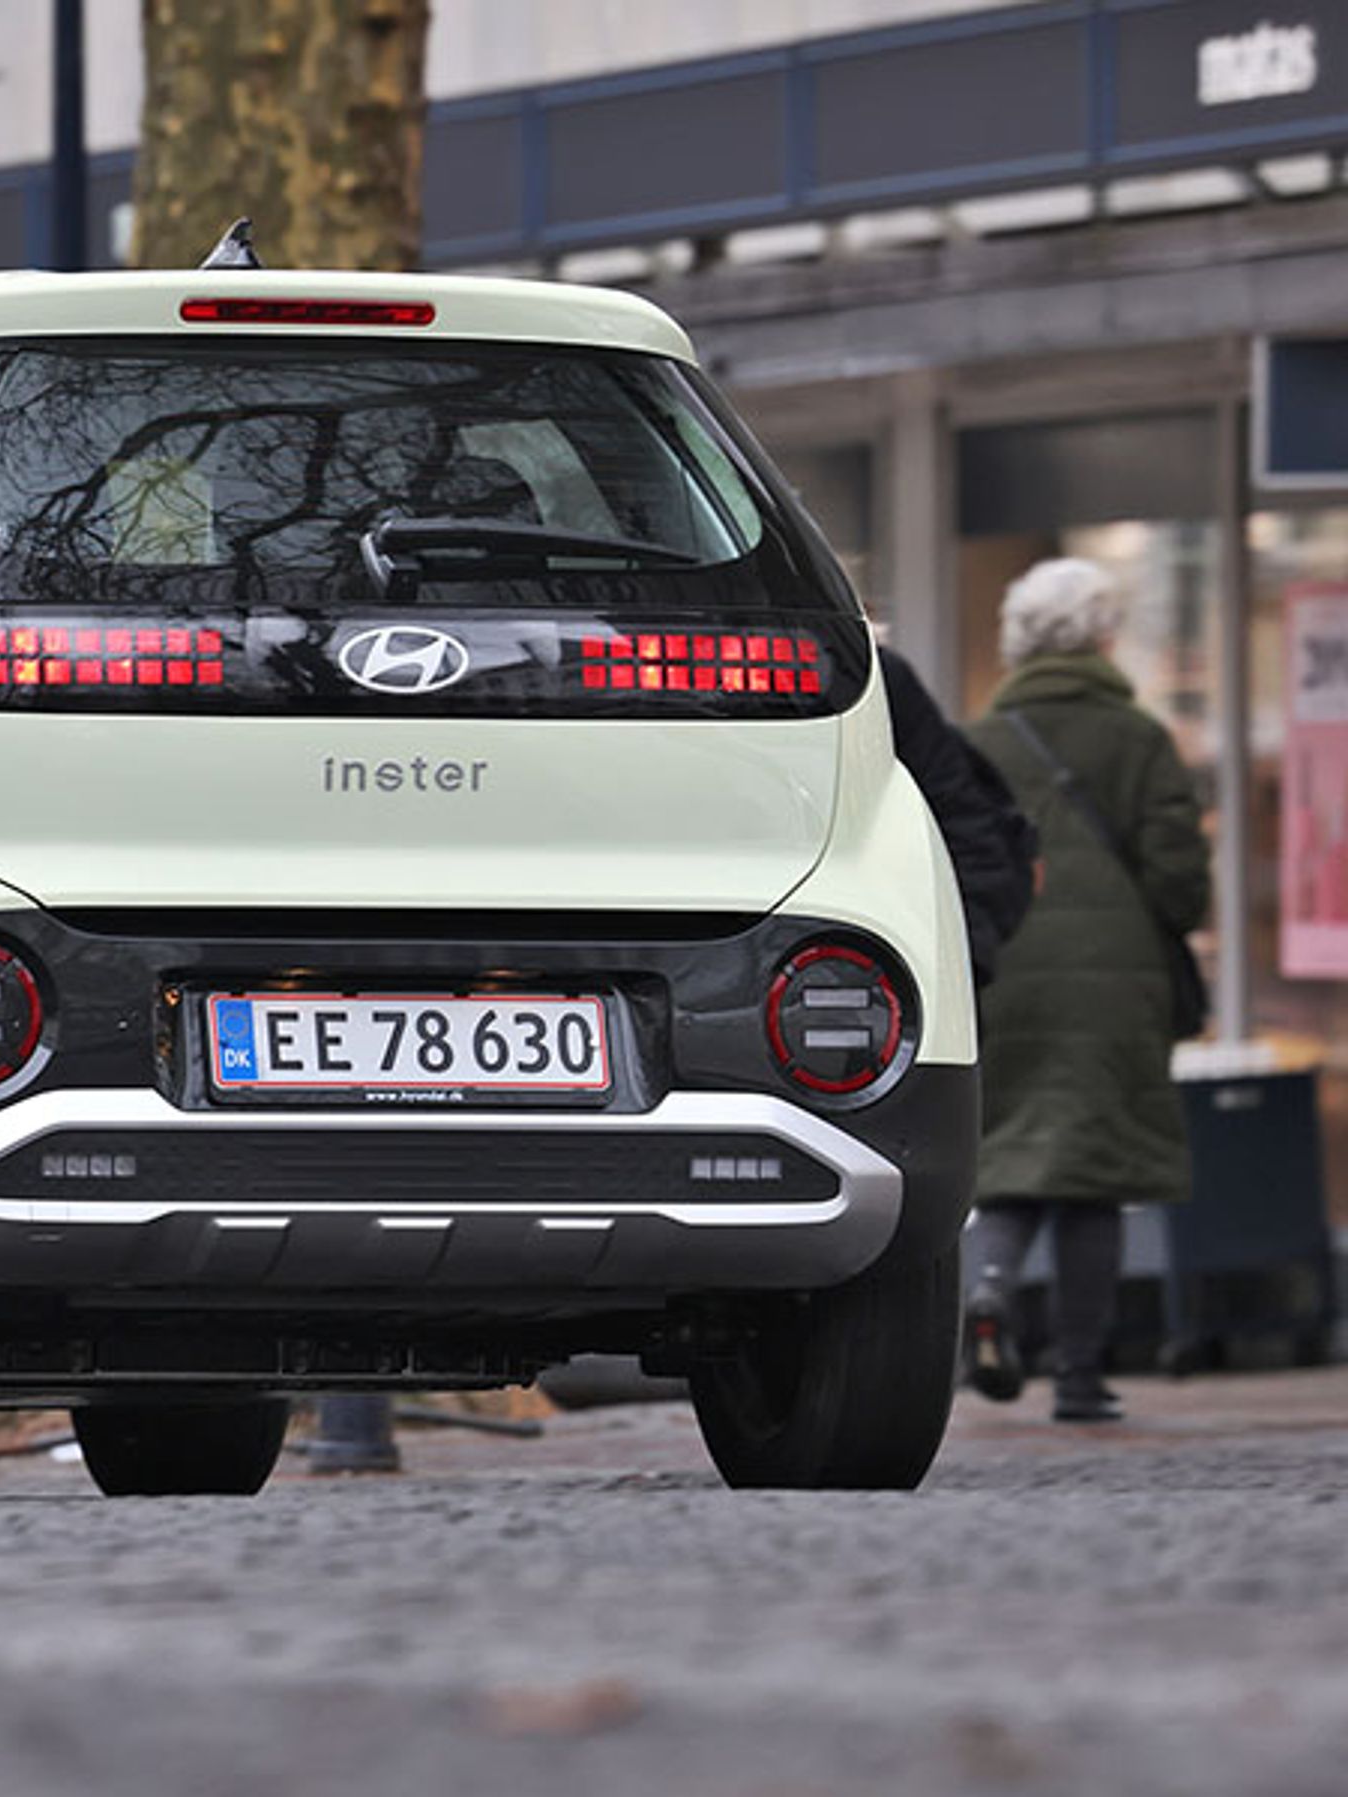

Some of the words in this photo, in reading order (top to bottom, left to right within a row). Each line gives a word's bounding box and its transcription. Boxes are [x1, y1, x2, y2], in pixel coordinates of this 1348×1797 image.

[324, 756, 488, 792] inster
[225, 1048, 251, 1068] DK
[266, 1011, 352, 1071] EE
[371, 1010, 453, 1074] 78
[472, 1010, 596, 1074] 630
